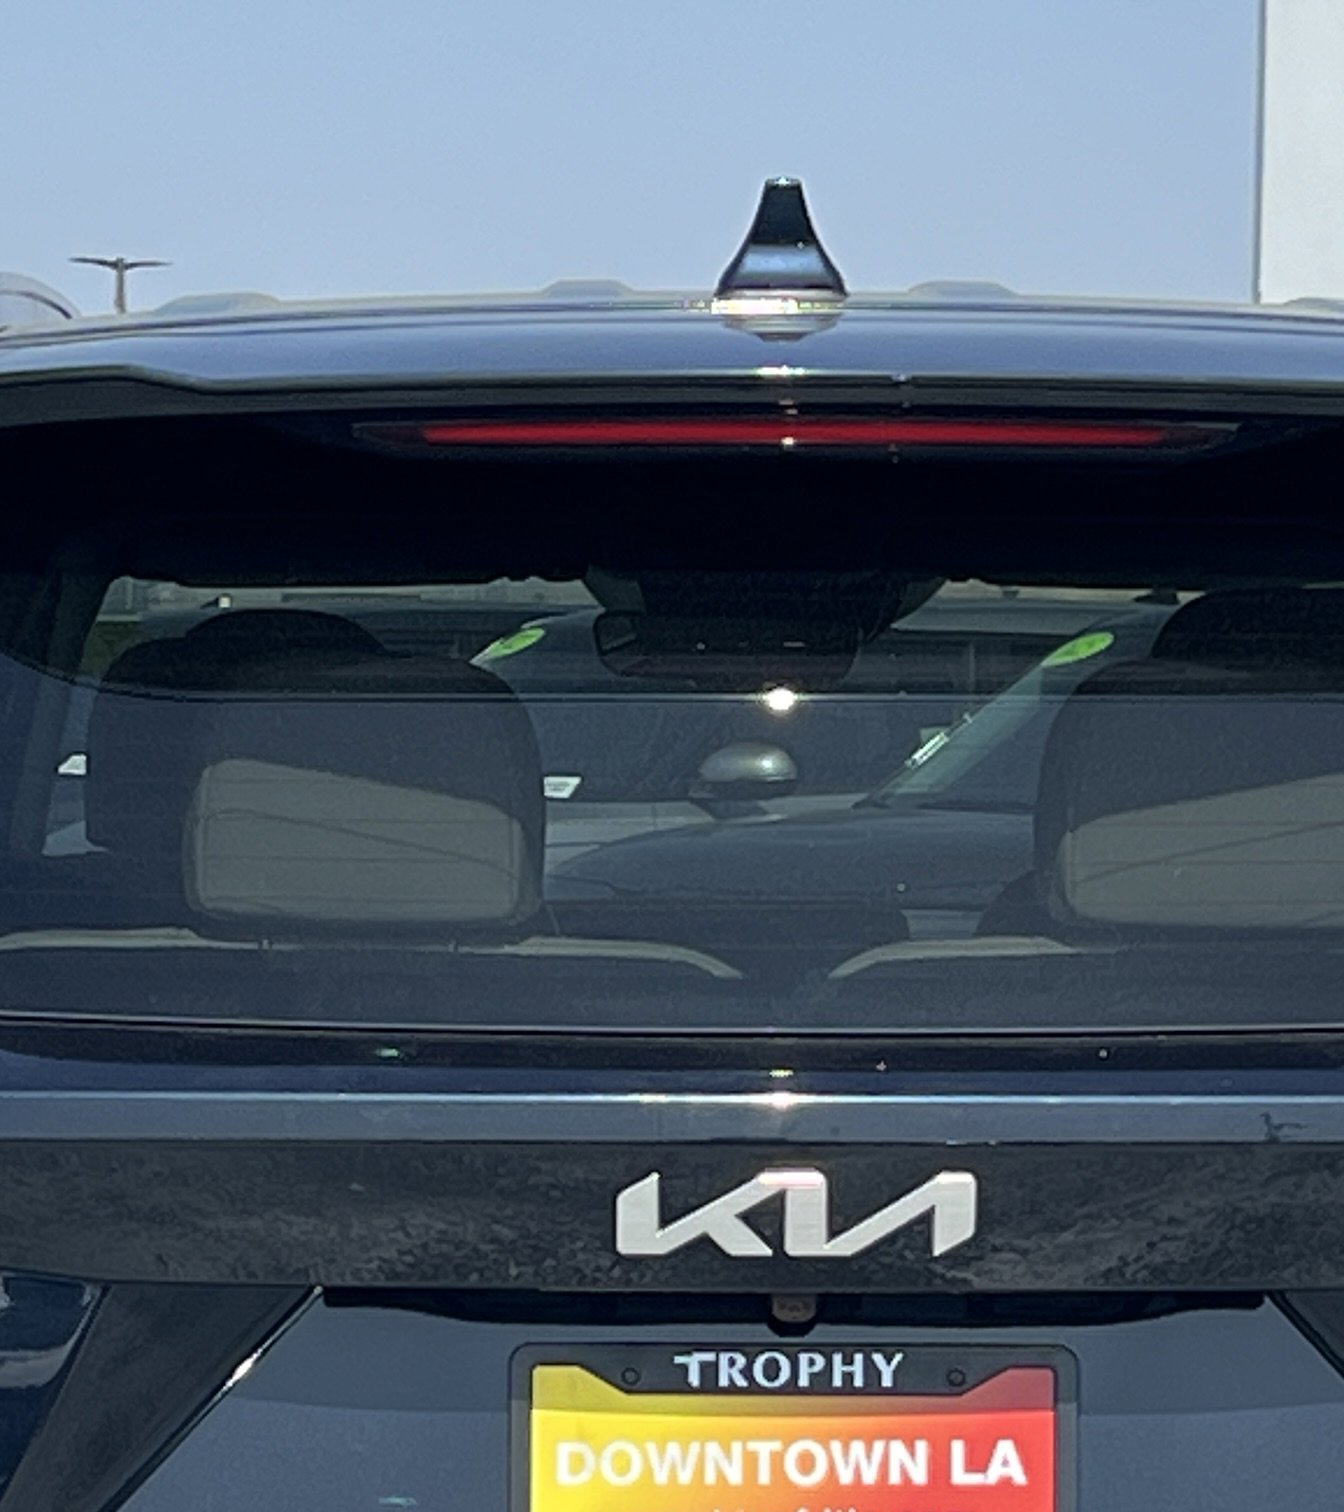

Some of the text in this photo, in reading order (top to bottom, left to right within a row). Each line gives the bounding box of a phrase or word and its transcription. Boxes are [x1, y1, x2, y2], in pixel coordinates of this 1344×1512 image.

[615, 1167, 978, 1258] KIA
[672, 1351, 905, 1389] TROPHY
[556, 1439, 1028, 1487] DOWNTOWN LA
